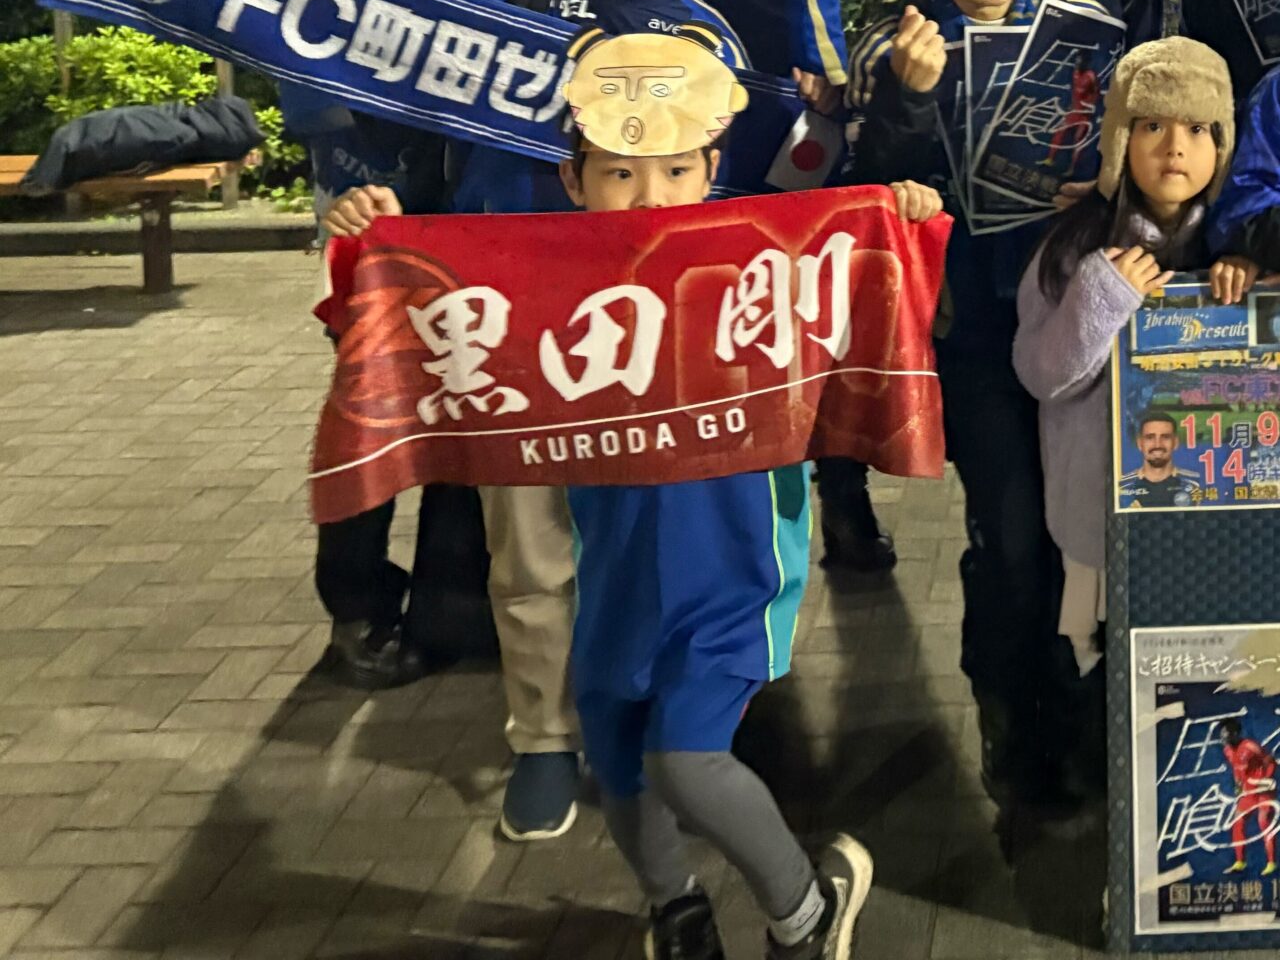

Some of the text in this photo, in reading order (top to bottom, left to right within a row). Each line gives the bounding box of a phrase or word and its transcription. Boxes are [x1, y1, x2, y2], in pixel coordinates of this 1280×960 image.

[998, 94, 1102, 150] 喰ら
[405, 230, 858, 426] 黒田剛
[520, 406, 748, 466] KURODA GO
[1169, 880, 1263, 905] 国立決戦
